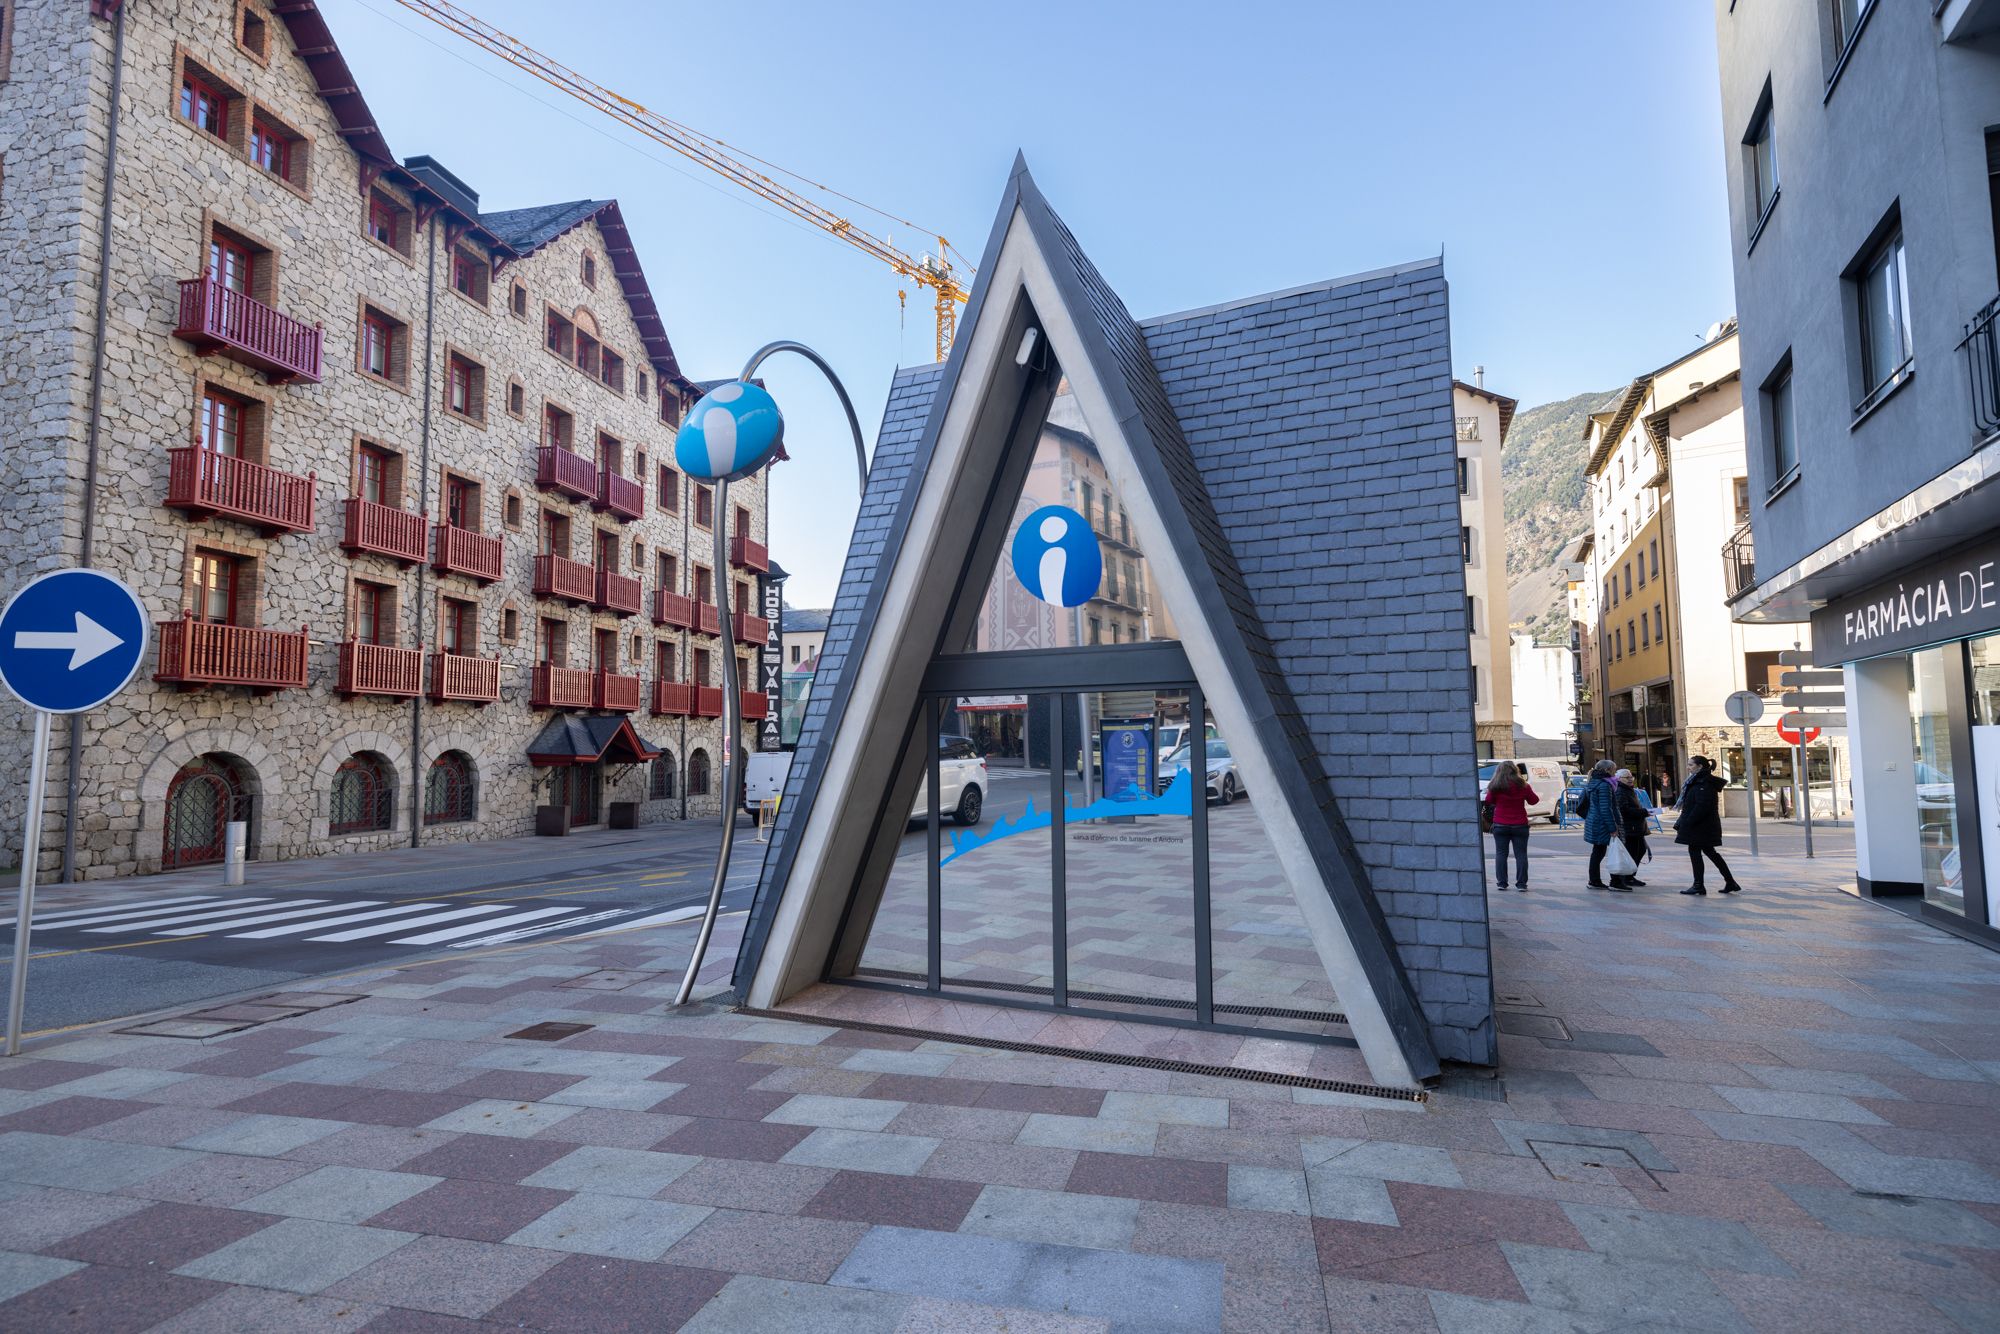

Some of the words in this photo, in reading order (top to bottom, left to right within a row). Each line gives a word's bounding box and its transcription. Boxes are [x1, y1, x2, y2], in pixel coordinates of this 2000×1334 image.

[1039, 516, 1068, 607] i
[765, 586, 779, 652] HOSTAL
[1845, 579, 1952, 646] FARMÀCIA
[1959, 561, 1996, 614] DE
[764, 666, 779, 734] VALIRA
[1119, 834, 1128, 842] de
[1152, 834, 1184, 844] d'Andorra
